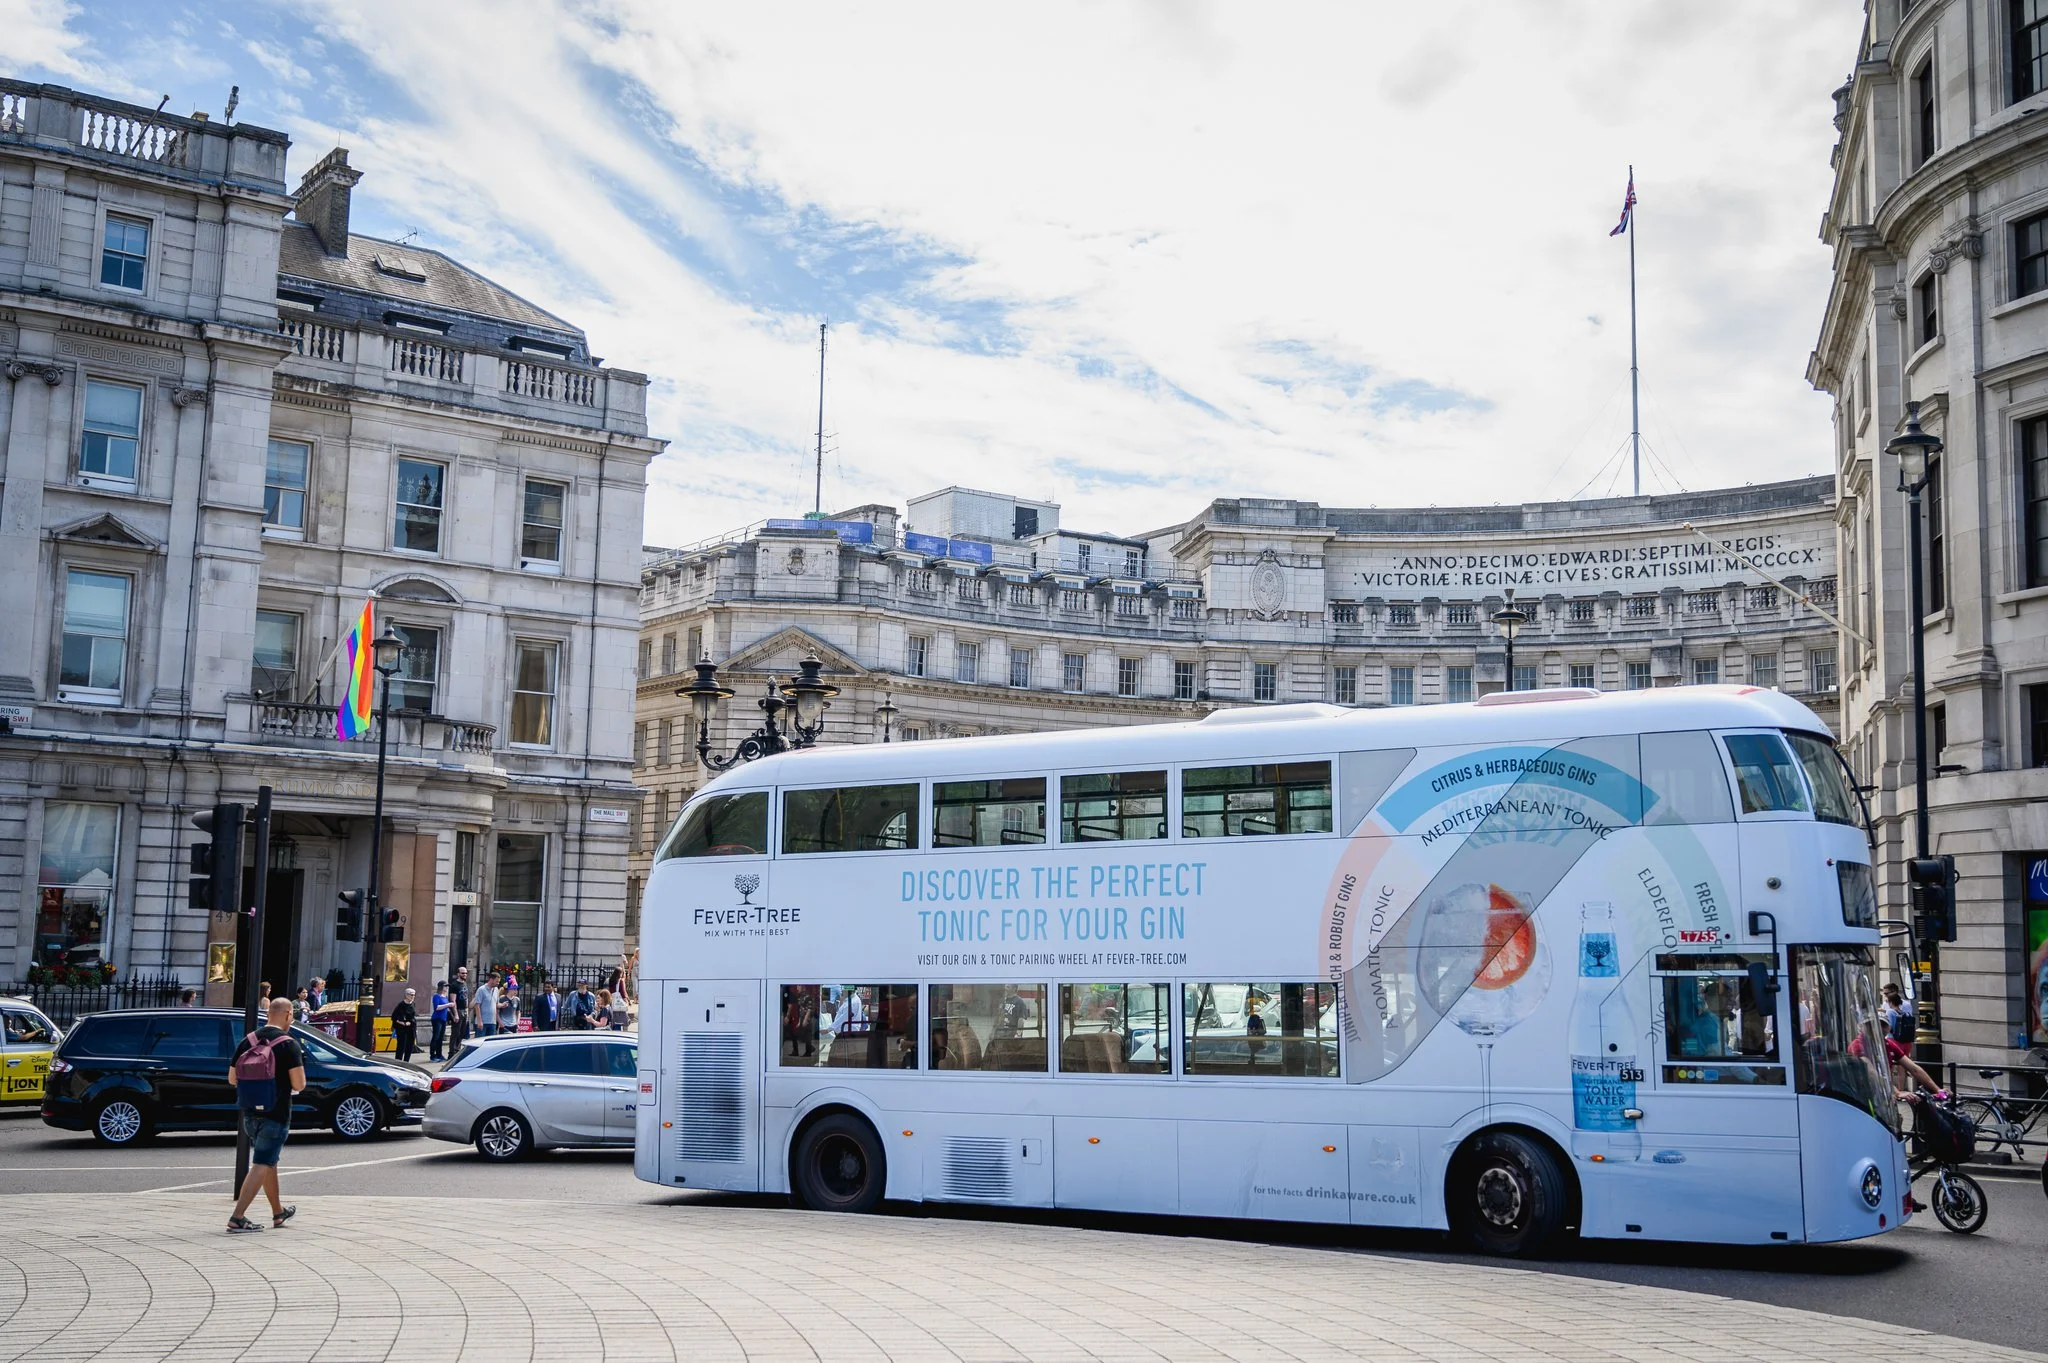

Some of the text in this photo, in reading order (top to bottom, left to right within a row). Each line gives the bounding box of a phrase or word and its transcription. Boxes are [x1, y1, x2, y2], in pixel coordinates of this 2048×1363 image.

[12, 715, 29, 723] SW1
[1431, 758, 1598, 793] CITRUS & HERBACEOUS GINS
[258, 778, 378, 798] DRUMMOND
[1421, 799, 1614, 847] MEDITERRANEAN TONIC
[902, 862, 1207, 902] DISCOVER THE PERFECT
[1338, 873, 1357, 902] GINS
[1370, 885, 1395, 935] TONIC
[1694, 881, 1719, 926] FRESH
[723, 929, 746, 937] WITH
[769, 928, 790, 936] BEST
[917, 906, 1184, 942] TONIC FOR YOUR GIN
[1329, 902, 1347, 950] ROBUST
[1679, 930, 1717, 942] LT755
[917, 952, 1187, 966] VISIT OUR GIN & TONIC PAIRING WHEEL AT FEVER-TREE.COM
[1329, 952, 1341, 962] &
[34, 1064, 48, 1072] THE
[1621, 1069, 1643, 1081] 513
[7, 1076, 39, 1093] LION
[1585, 1085, 1624, 1096] TONIC
[1583, 1096, 1626, 1106] WATER
[1253, 1185, 1416, 1205] for the facts drinkaware.co.uk
